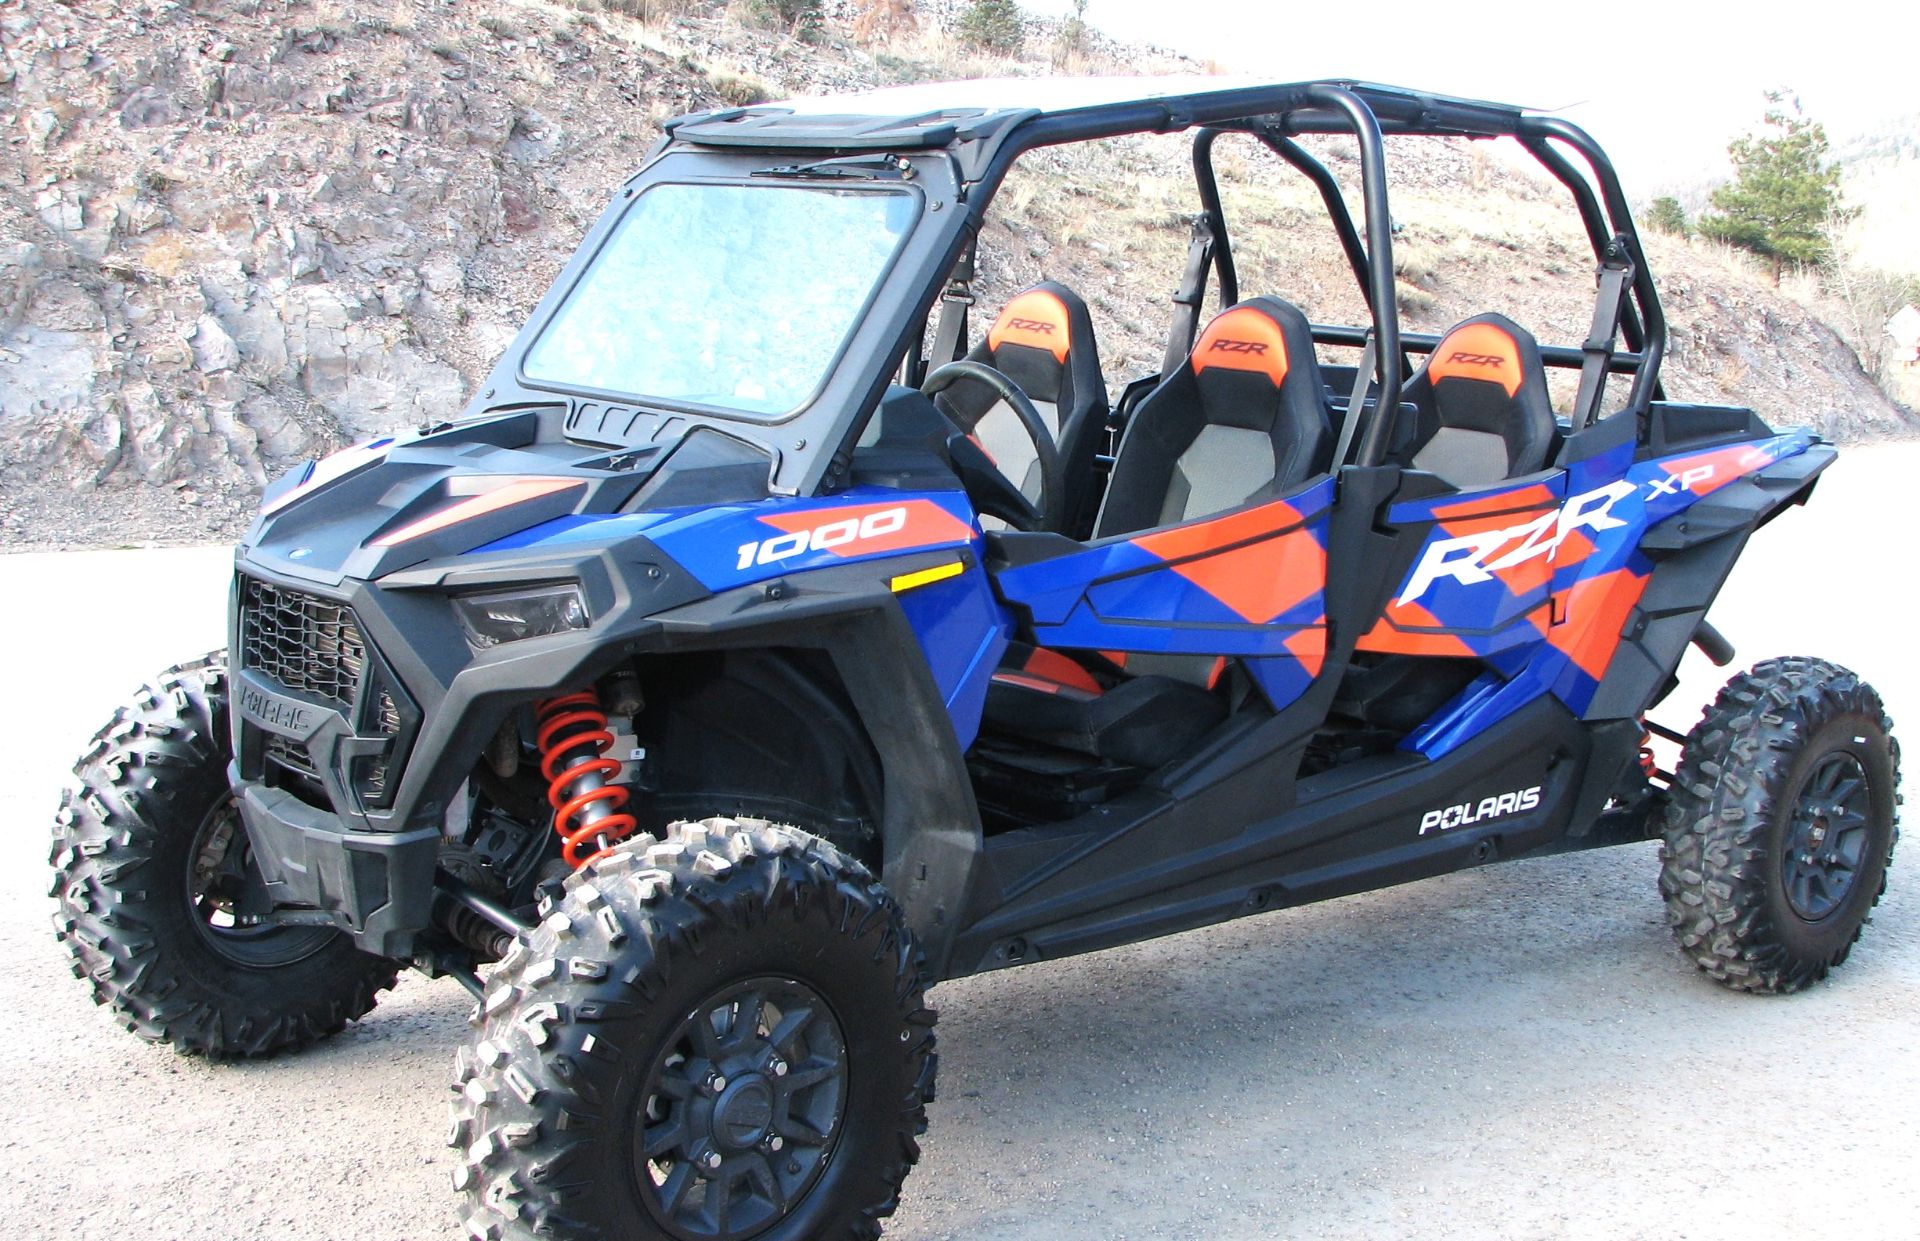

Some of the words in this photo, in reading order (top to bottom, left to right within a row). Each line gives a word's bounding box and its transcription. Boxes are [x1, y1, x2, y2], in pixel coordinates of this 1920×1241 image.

[1006, 318, 1056, 335] RZR
[1208, 339, 1269, 356] RZR
[1446, 352, 1504, 368] RZR
[737, 507, 906, 570] 1000
[1396, 479, 1638, 608] RZR
[1644, 464, 1715, 502] XP
[1418, 786, 1541, 835] POLARIS
